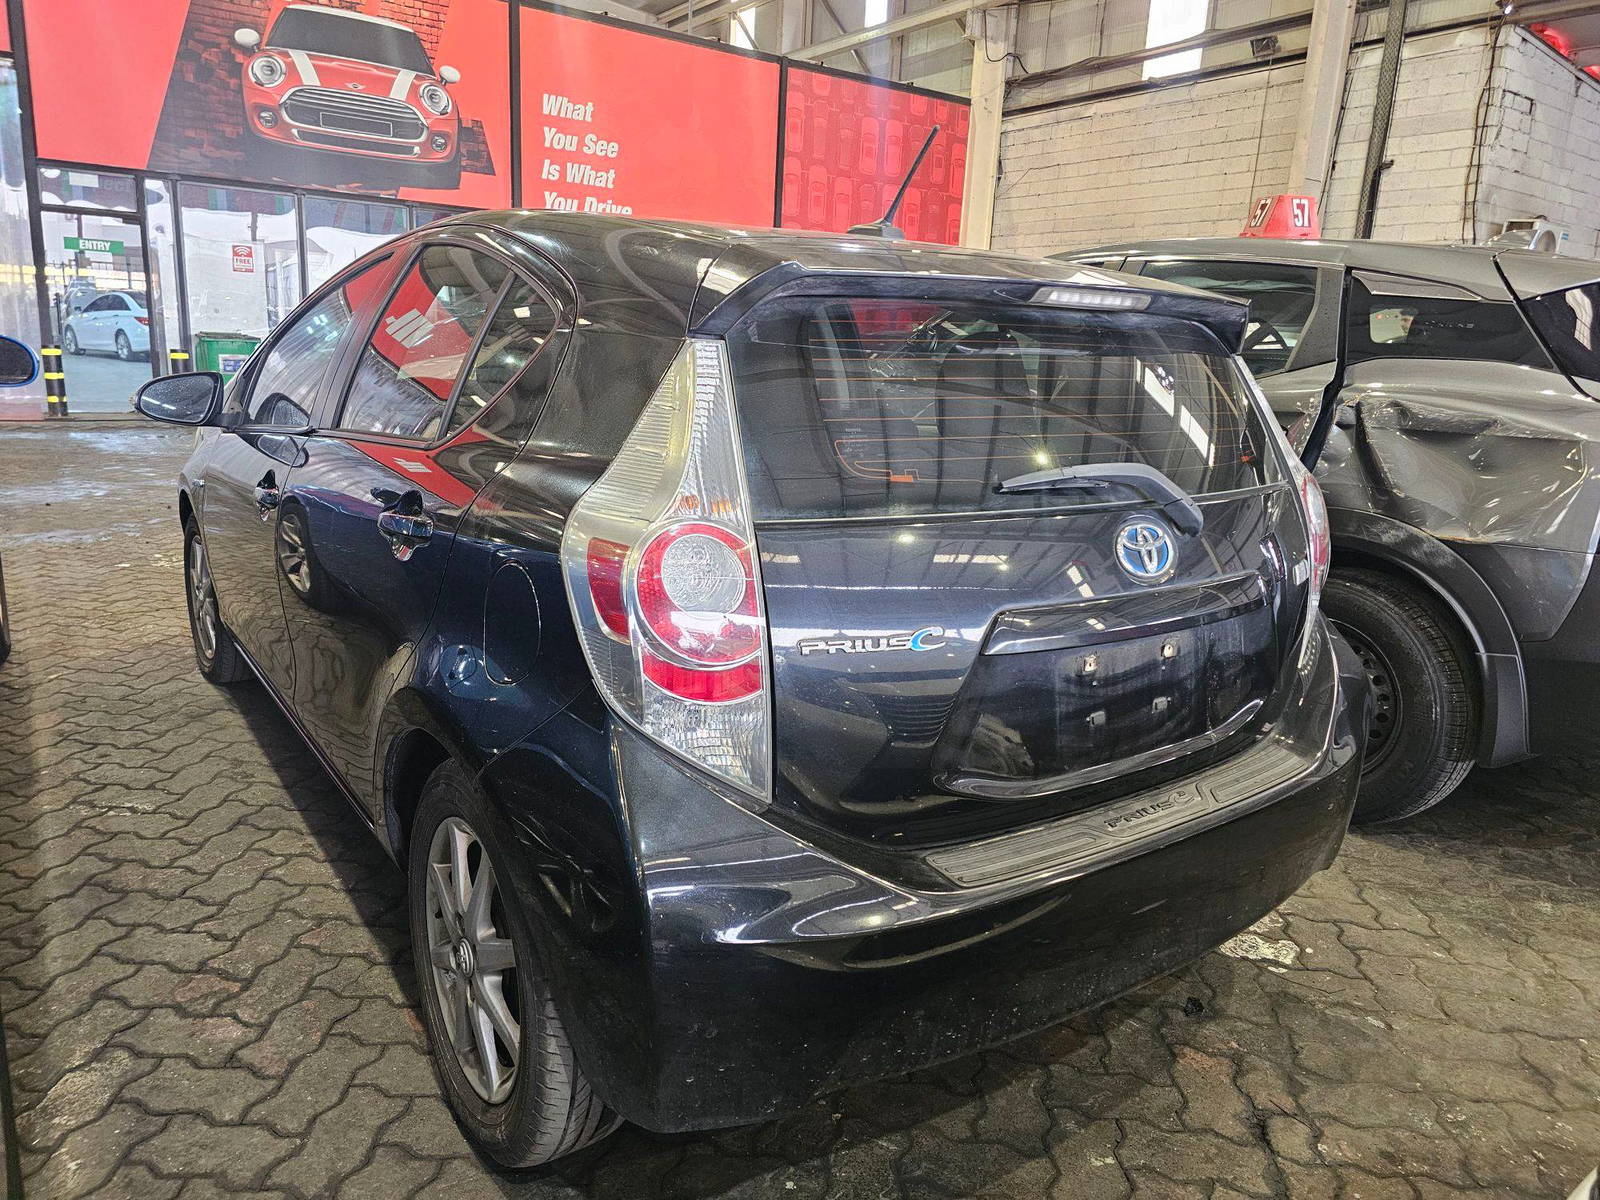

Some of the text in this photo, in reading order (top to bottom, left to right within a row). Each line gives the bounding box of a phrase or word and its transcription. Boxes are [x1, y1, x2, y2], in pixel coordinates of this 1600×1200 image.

[543, 93, 593, 122] What
[543, 126, 619, 158] You See
[541, 159, 616, 189] Is What
[544, 191, 633, 215] You Drive
[1250, 198, 1272, 227] 57
[1292, 198, 1309, 227] 57
[79, 241, 111, 251] ENTRY
[235, 257, 251, 265] FREE
[798, 636, 911, 656] PRIUS
[1104, 800, 1174, 828] PRIUS
